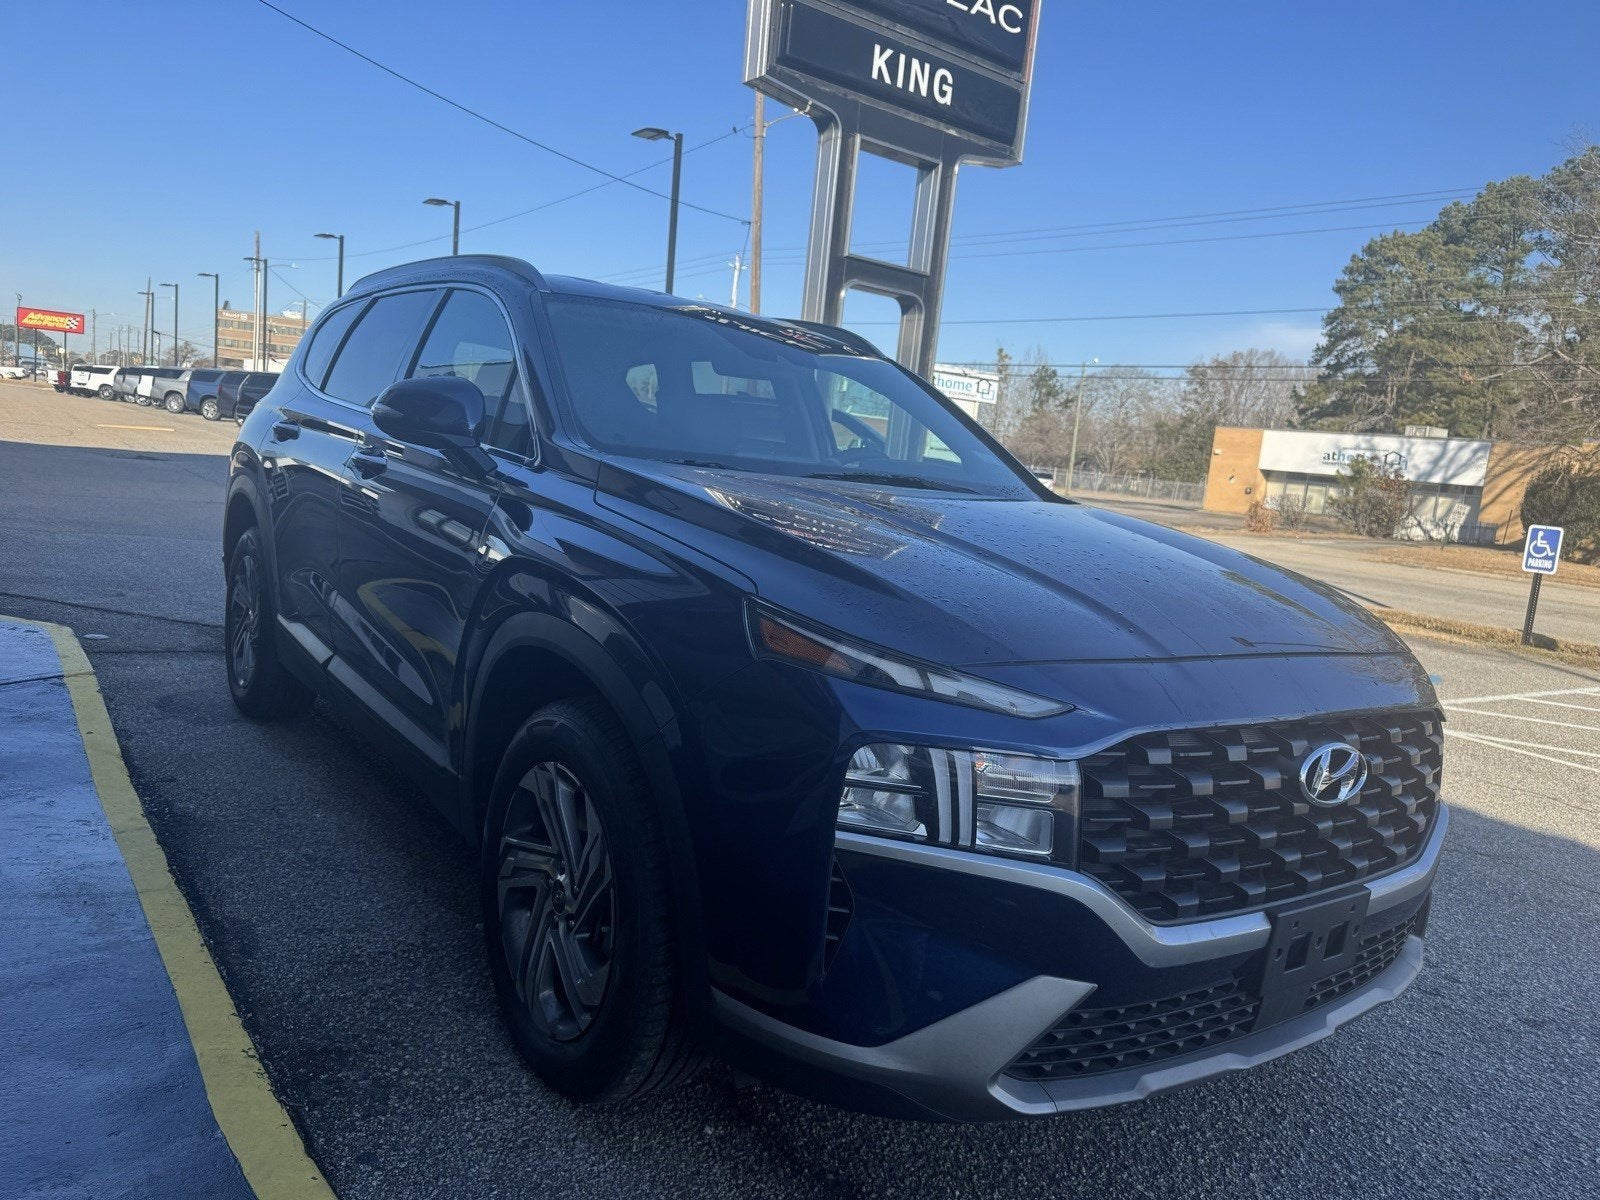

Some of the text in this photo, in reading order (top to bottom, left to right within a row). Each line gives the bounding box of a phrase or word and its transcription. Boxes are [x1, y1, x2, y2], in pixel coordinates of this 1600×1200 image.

[871, 44, 953, 106] KING
[26, 311, 67, 323] Advance
[1527, 557, 1553, 569] PARKING
